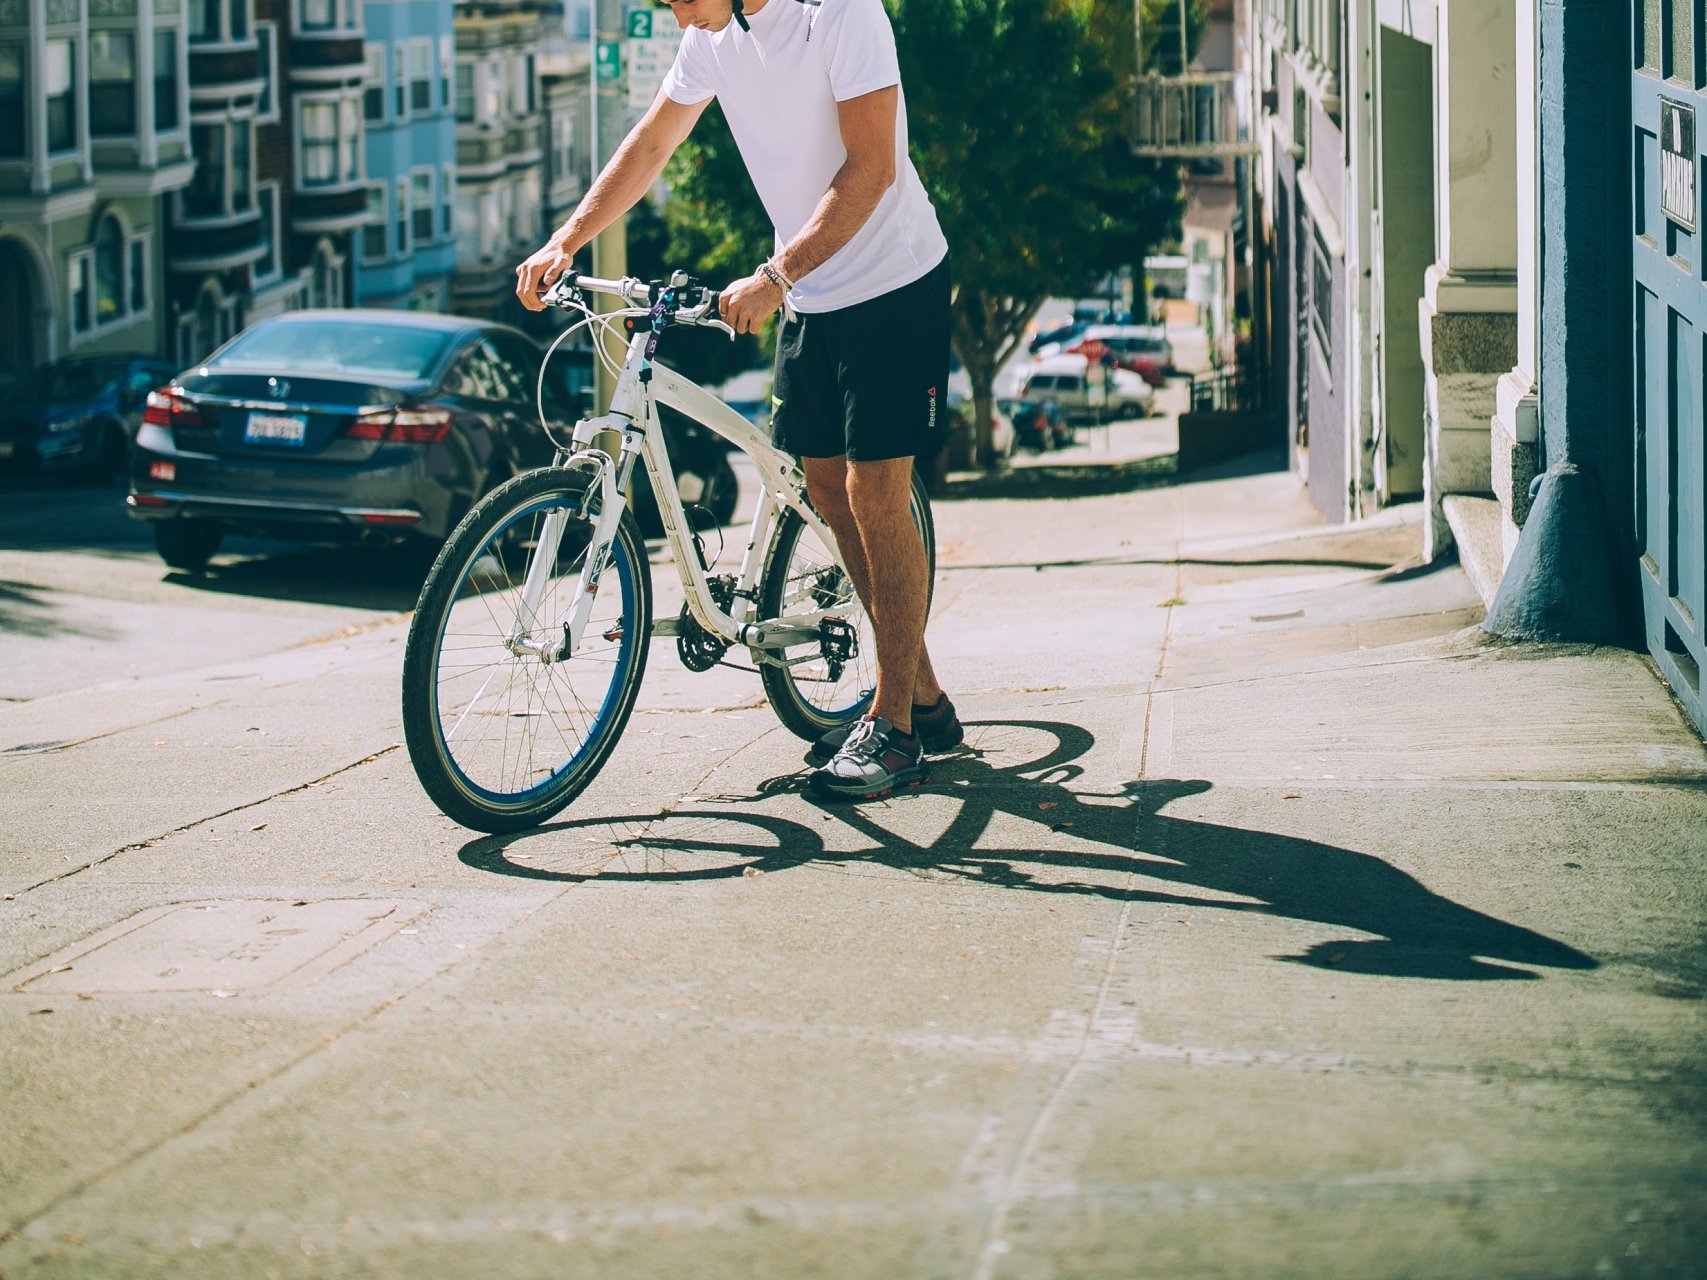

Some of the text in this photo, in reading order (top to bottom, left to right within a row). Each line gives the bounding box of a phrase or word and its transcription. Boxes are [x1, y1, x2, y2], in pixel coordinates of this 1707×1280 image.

[634, 14, 648, 36] 2
[1662, 149, 1693, 222] PARKING
[928, 397, 936, 427] Reebok
